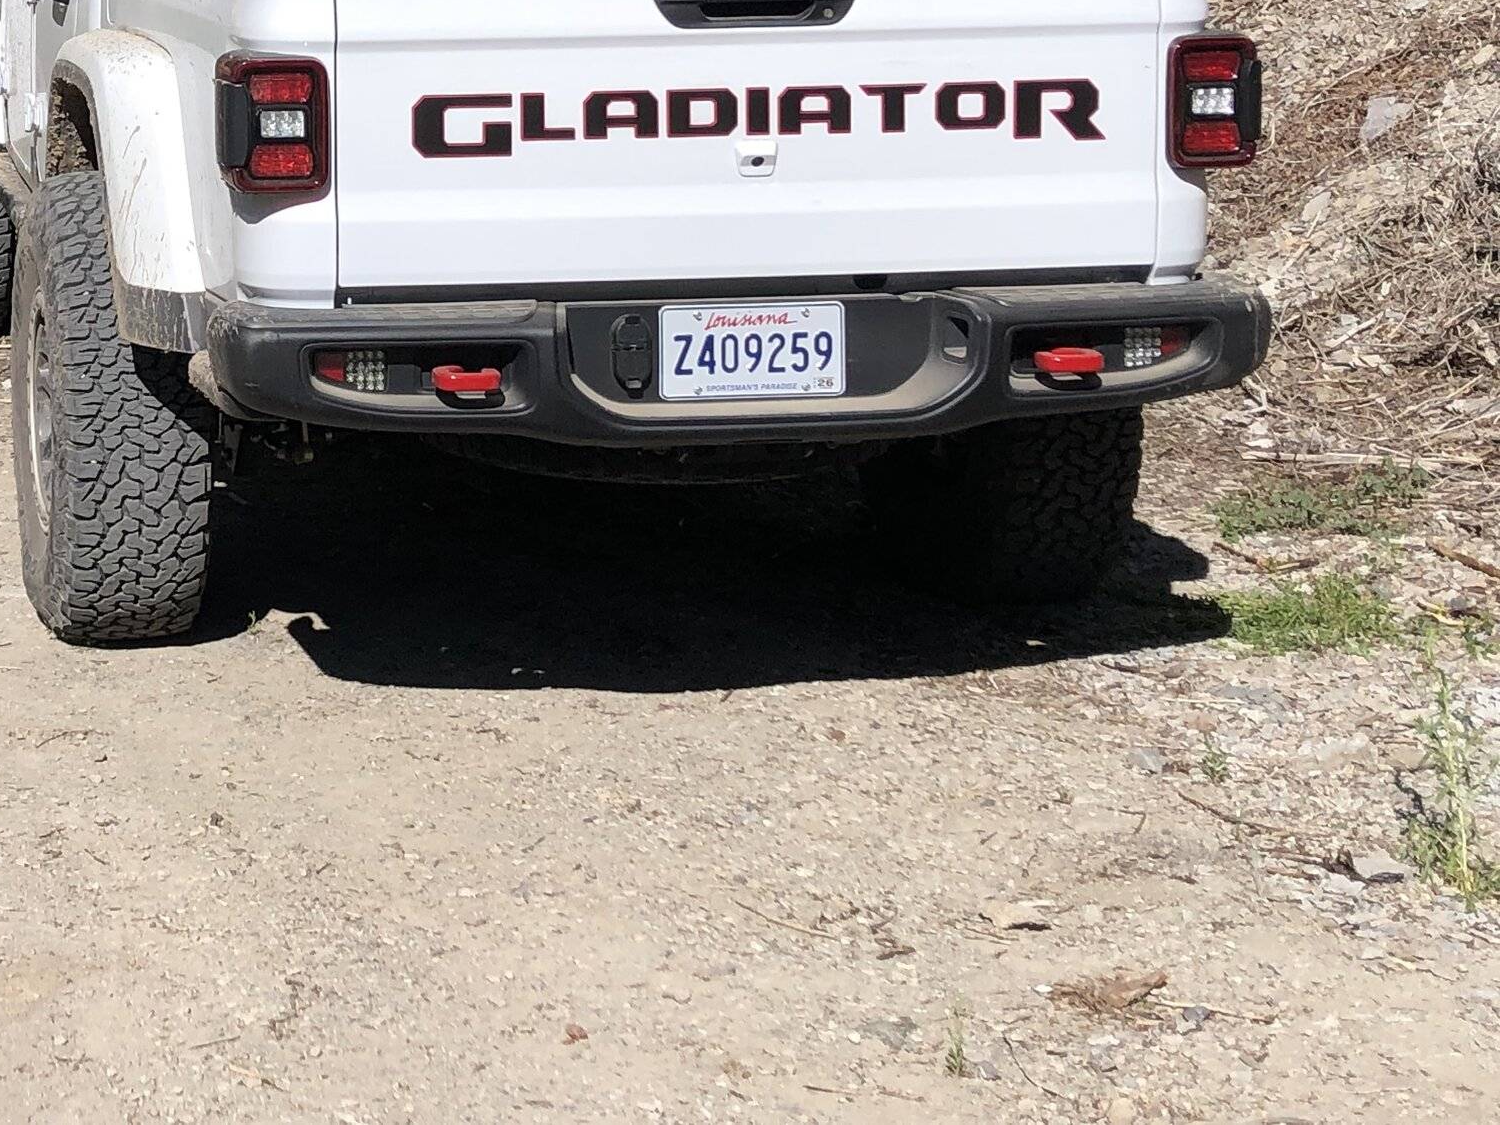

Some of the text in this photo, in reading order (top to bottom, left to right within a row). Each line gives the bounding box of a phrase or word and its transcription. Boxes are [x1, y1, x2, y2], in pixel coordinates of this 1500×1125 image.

[411, 77, 1106, 159] GLADIATOR
[704, 312, 798, 331] Louisiana
[673, 330, 834, 375] Z409259
[706, 381, 799, 393] SPORTSMAN'S PARADISE
